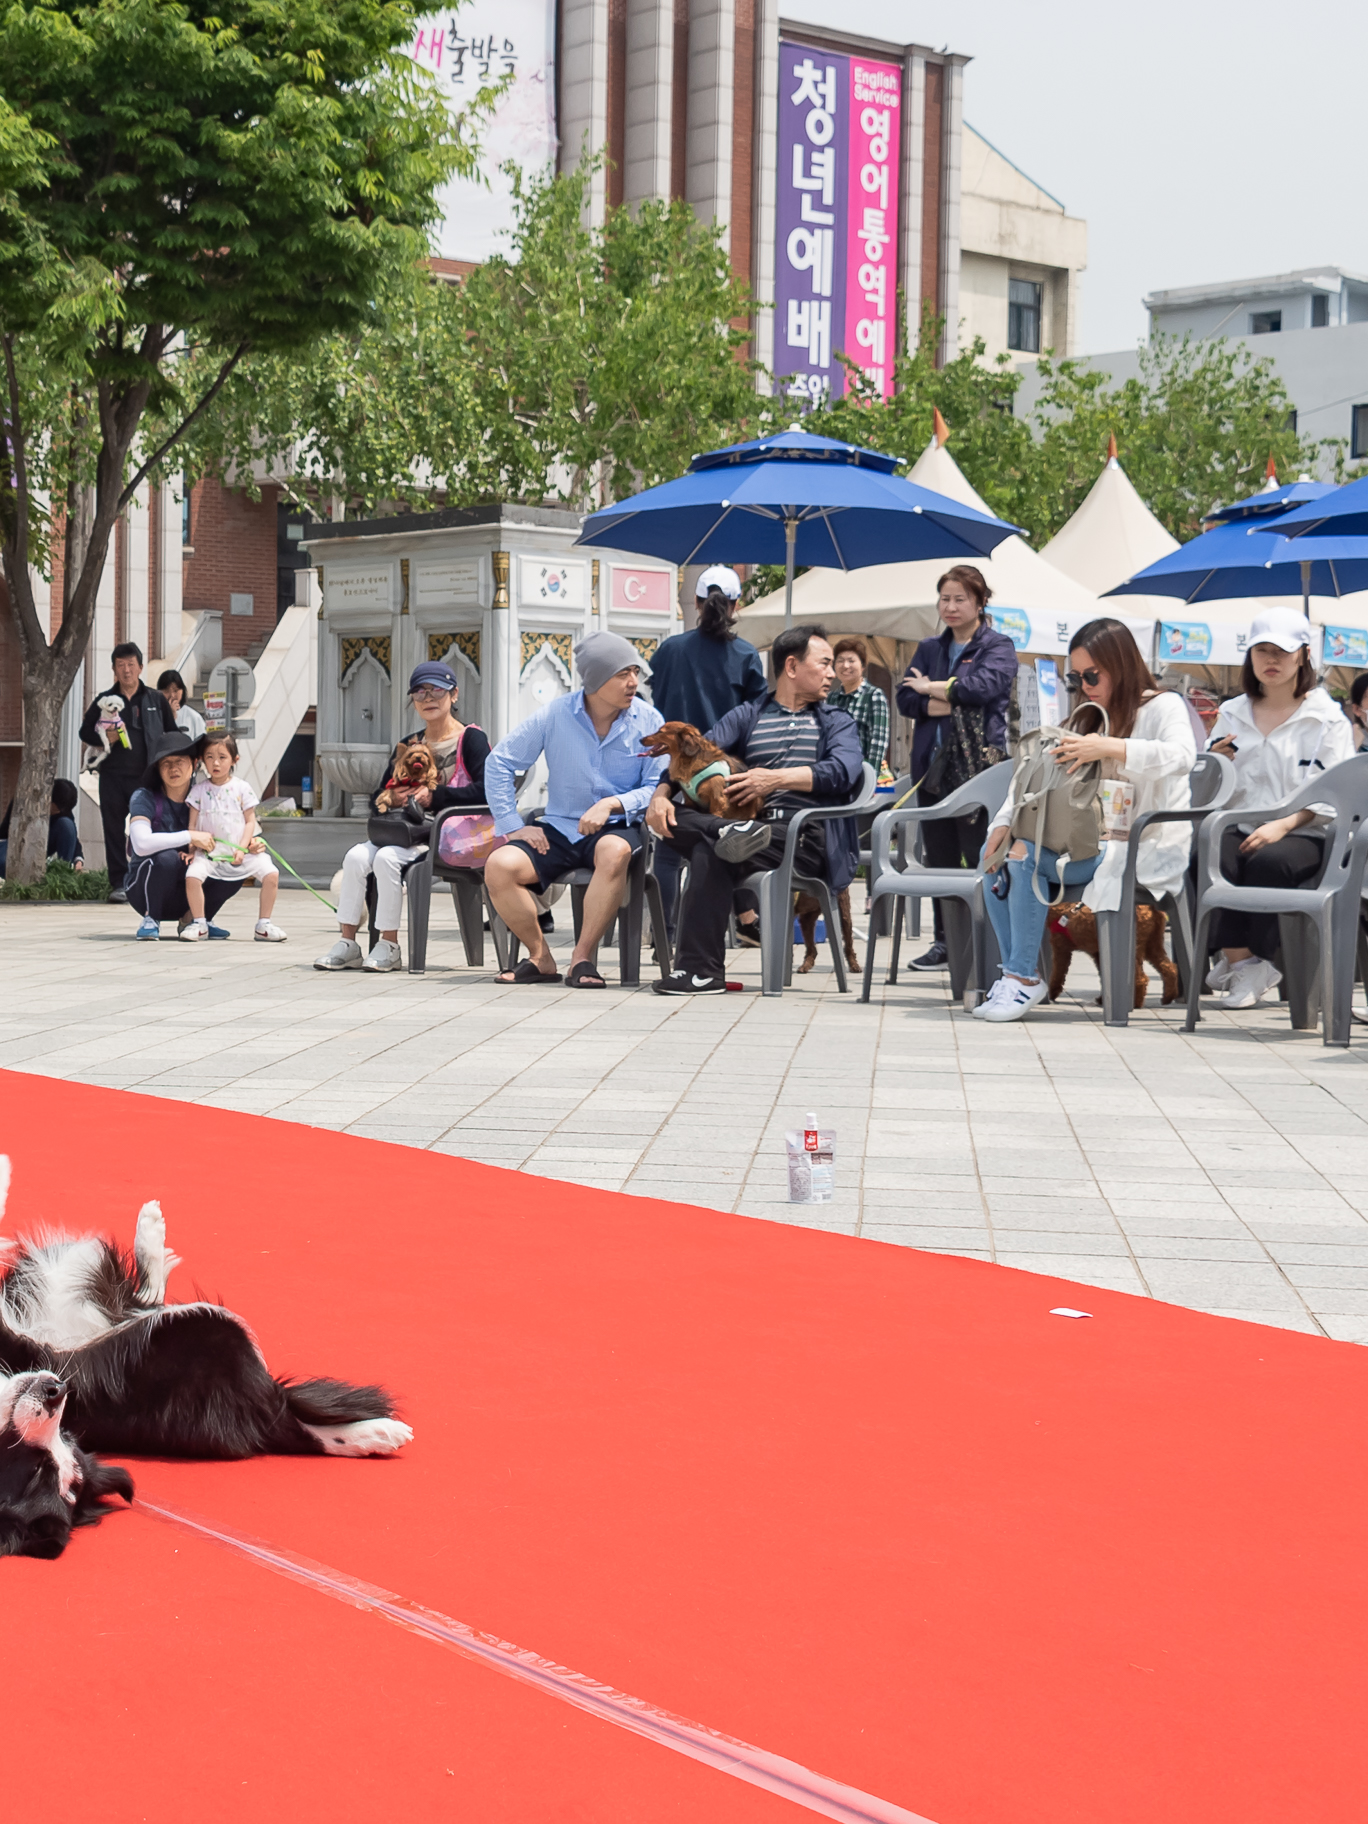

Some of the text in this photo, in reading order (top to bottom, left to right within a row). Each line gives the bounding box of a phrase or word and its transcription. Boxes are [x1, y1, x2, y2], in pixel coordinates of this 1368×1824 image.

[854, 66, 899, 91] English
[854, 84, 900, 108] Service
[786, 58, 837, 369] 청년예배
